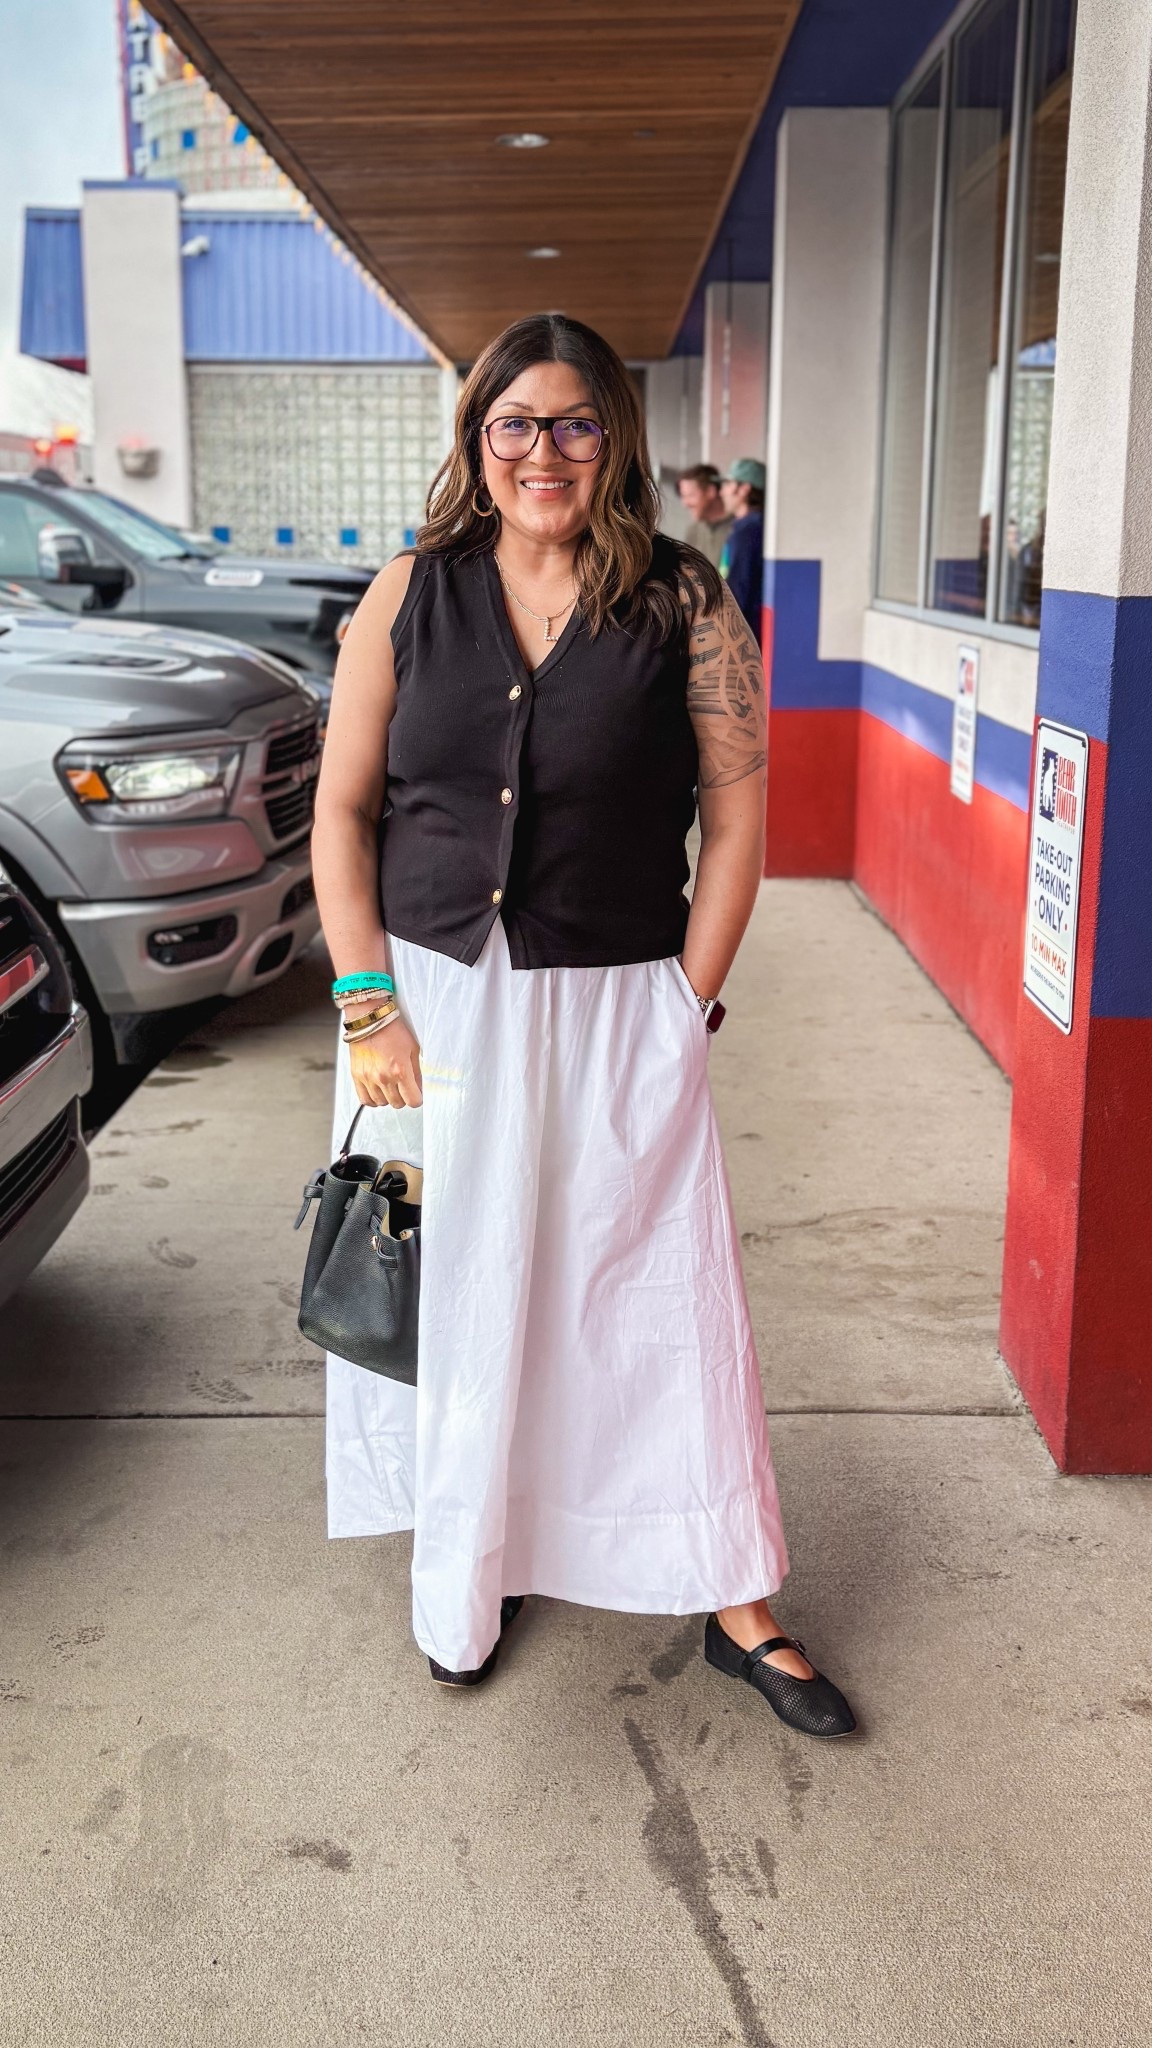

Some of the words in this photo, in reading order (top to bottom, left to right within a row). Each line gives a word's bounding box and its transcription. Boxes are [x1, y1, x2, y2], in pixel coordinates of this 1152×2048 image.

[1058, 756, 1076, 793] BEAR
[1056, 788, 1078, 827] TOOTH
[1037, 836, 1073, 877] TAKE-OUT
[1035, 862, 1071, 906] PARKING
[1038, 895, 1064, 934] ONLY
[1031, 933, 1038, 953] 10
[1038, 940, 1051, 963] MIN
[1051, 950, 1067, 978] MAX
